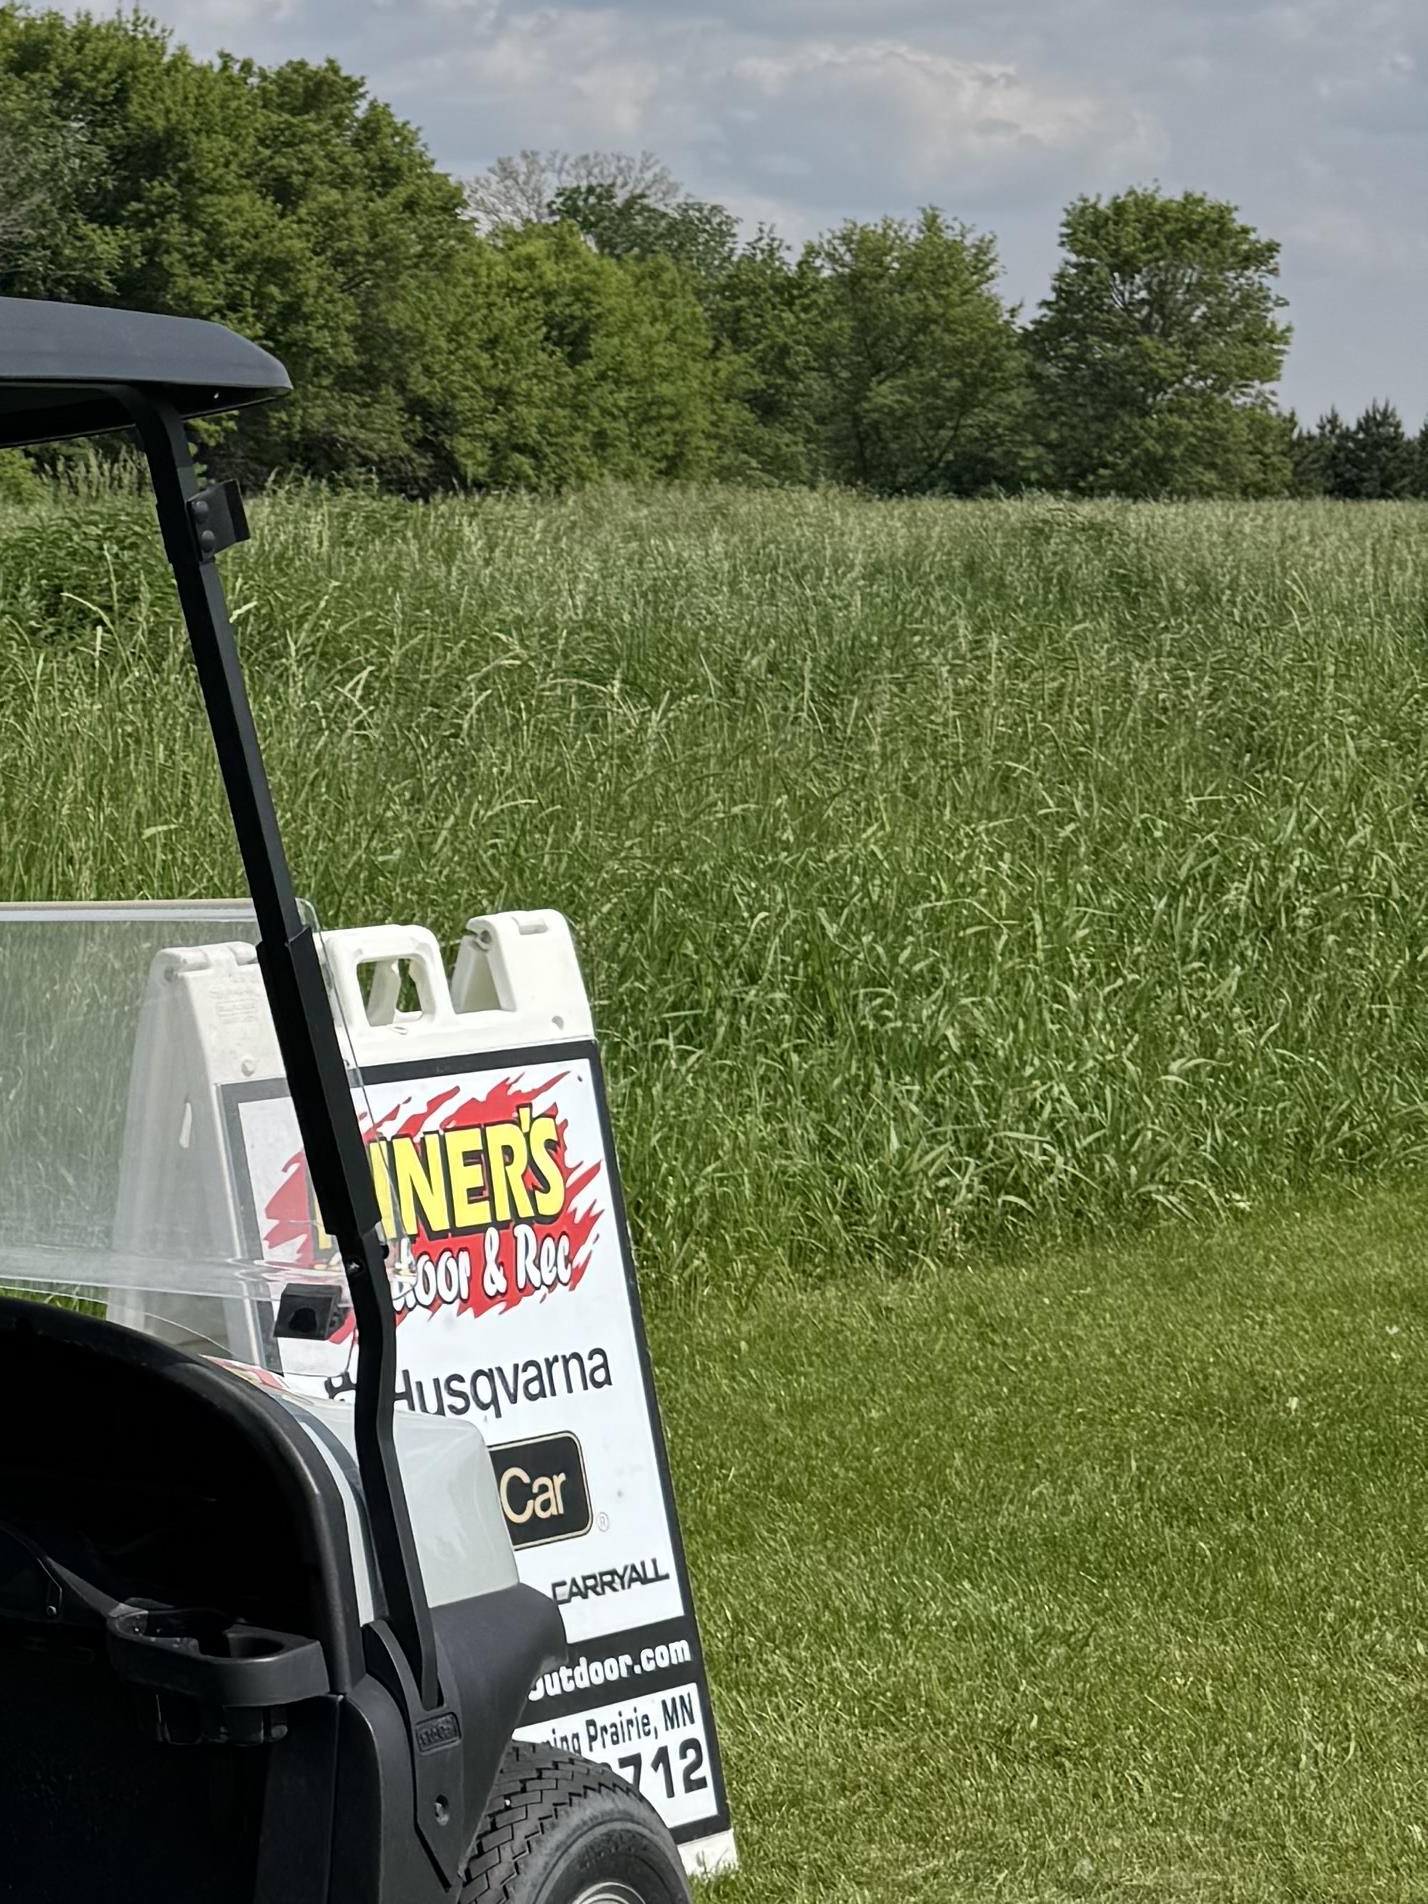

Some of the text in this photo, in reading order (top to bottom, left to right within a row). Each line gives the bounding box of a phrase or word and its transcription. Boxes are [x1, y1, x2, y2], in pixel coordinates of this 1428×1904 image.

[312, 1105, 566, 1248] INER'S
[483, 1227, 507, 1296] &
[515, 1224, 572, 1289] Rec
[500, 1466, 566, 1524] Car
[551, 1558, 670, 1604] CARRYALL
[585, 1706, 658, 1752] Prairie,
[661, 1692, 695, 1731] MN
[599, 1737, 708, 1799] 712
